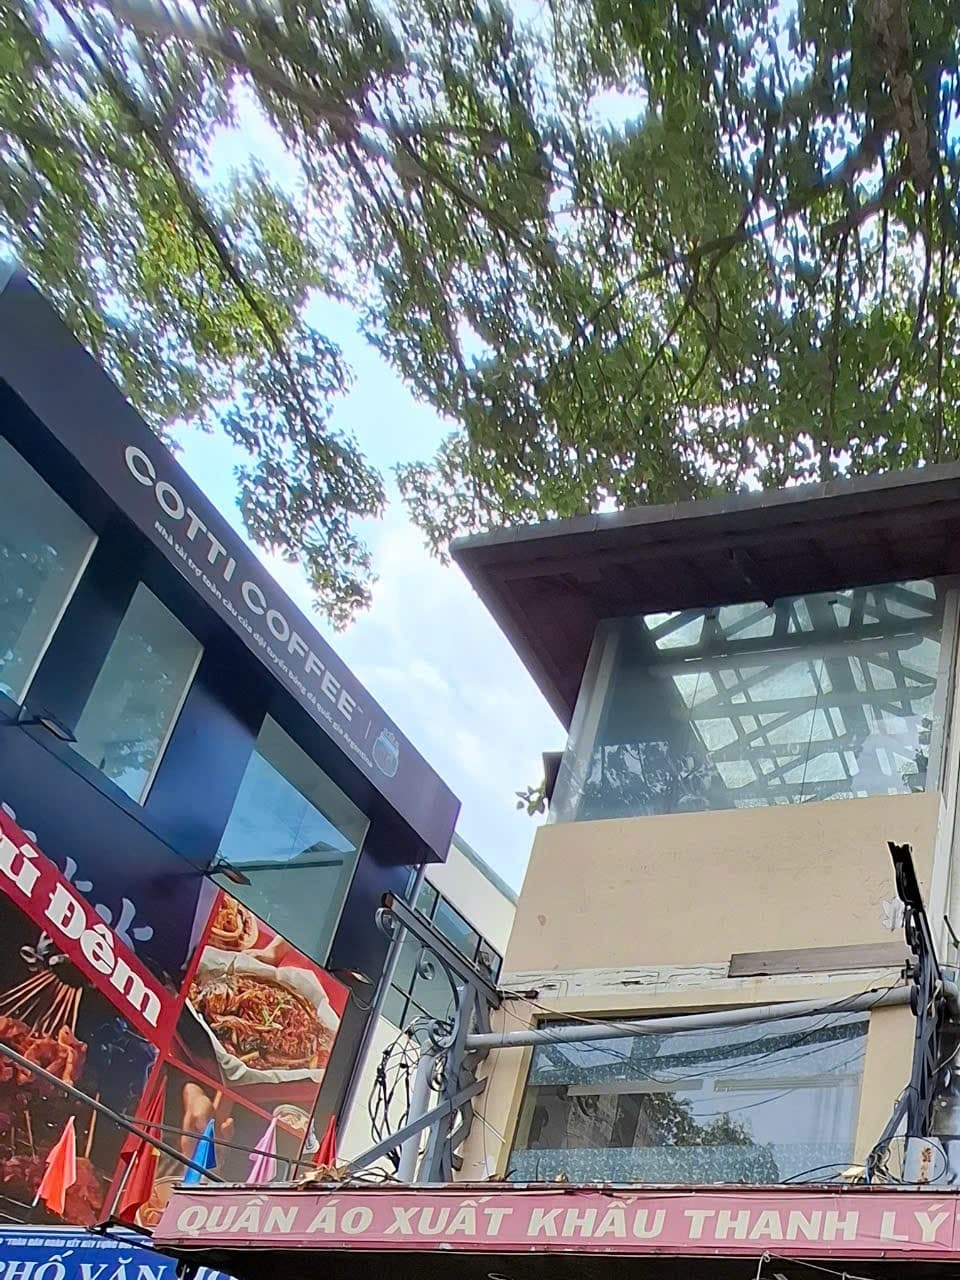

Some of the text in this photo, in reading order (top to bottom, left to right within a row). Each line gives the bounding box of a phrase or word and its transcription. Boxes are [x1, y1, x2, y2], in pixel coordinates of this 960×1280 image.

[125, 446, 357, 722] COTTI COFFEE
[44, 881, 162, 1028] Đêm
[305, 1199, 375, 1235] ÁO
[383, 1196, 514, 1237] XUẤT
[684, 1209, 860, 1241] THANH
[879, 1203, 950, 1242] LÝ
